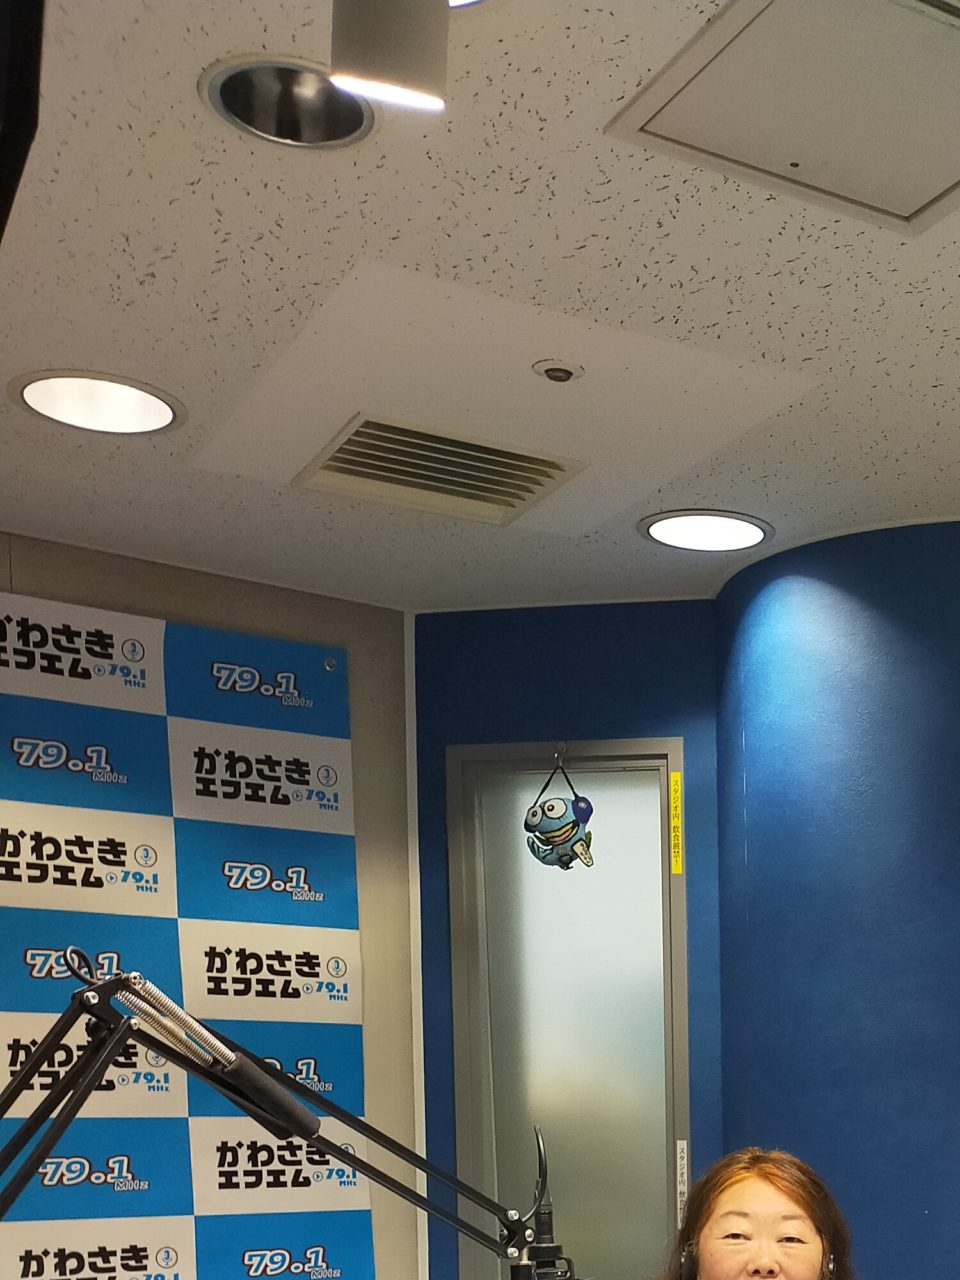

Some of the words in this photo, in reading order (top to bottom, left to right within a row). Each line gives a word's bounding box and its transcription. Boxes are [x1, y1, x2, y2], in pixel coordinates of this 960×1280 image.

[108, 663, 146, 681] 79.1
[124, 679, 146, 689] MHz
[212, 662, 299, 697] 79.1
[282, 694, 314, 708] MHz
[12, 737, 111, 772] 79.1
[92, 770, 128, 784] MHz
[193, 746, 311, 786] かわさき
[195, 777, 291, 806] エフエム
[305, 789, 339, 804] 79.1
[0, 828, 127, 867] かわさき
[0, 863, 104, 888] エフエム
[120, 870, 159, 885] 79.1
[135, 884, 159, 894] MHz
[223, 861, 310, 892] 79.1
[292, 890, 324, 901] MHz
[205, 947, 321, 978] かわさき
[207, 976, 301, 999] エフエム
[315, 981, 348, 994] 79.1
[329, 993, 348, 1001] MHz
[132, 1071, 170, 1084] 79.1
[216, 1140, 331, 1168] かわさき
[39, 1155, 133, 1185] 79.1
[113, 1178, 150, 1191] MHz
[218, 1168, 312, 1189] エフエム
[325, 1167, 357, 1180] 79.1
[339, 1179, 357, 1187] MHz
[19, 1245, 148, 1279] かわさき
[243, 1246, 328, 1277] 79.1
[310, 1269, 341, 1280] MHz
